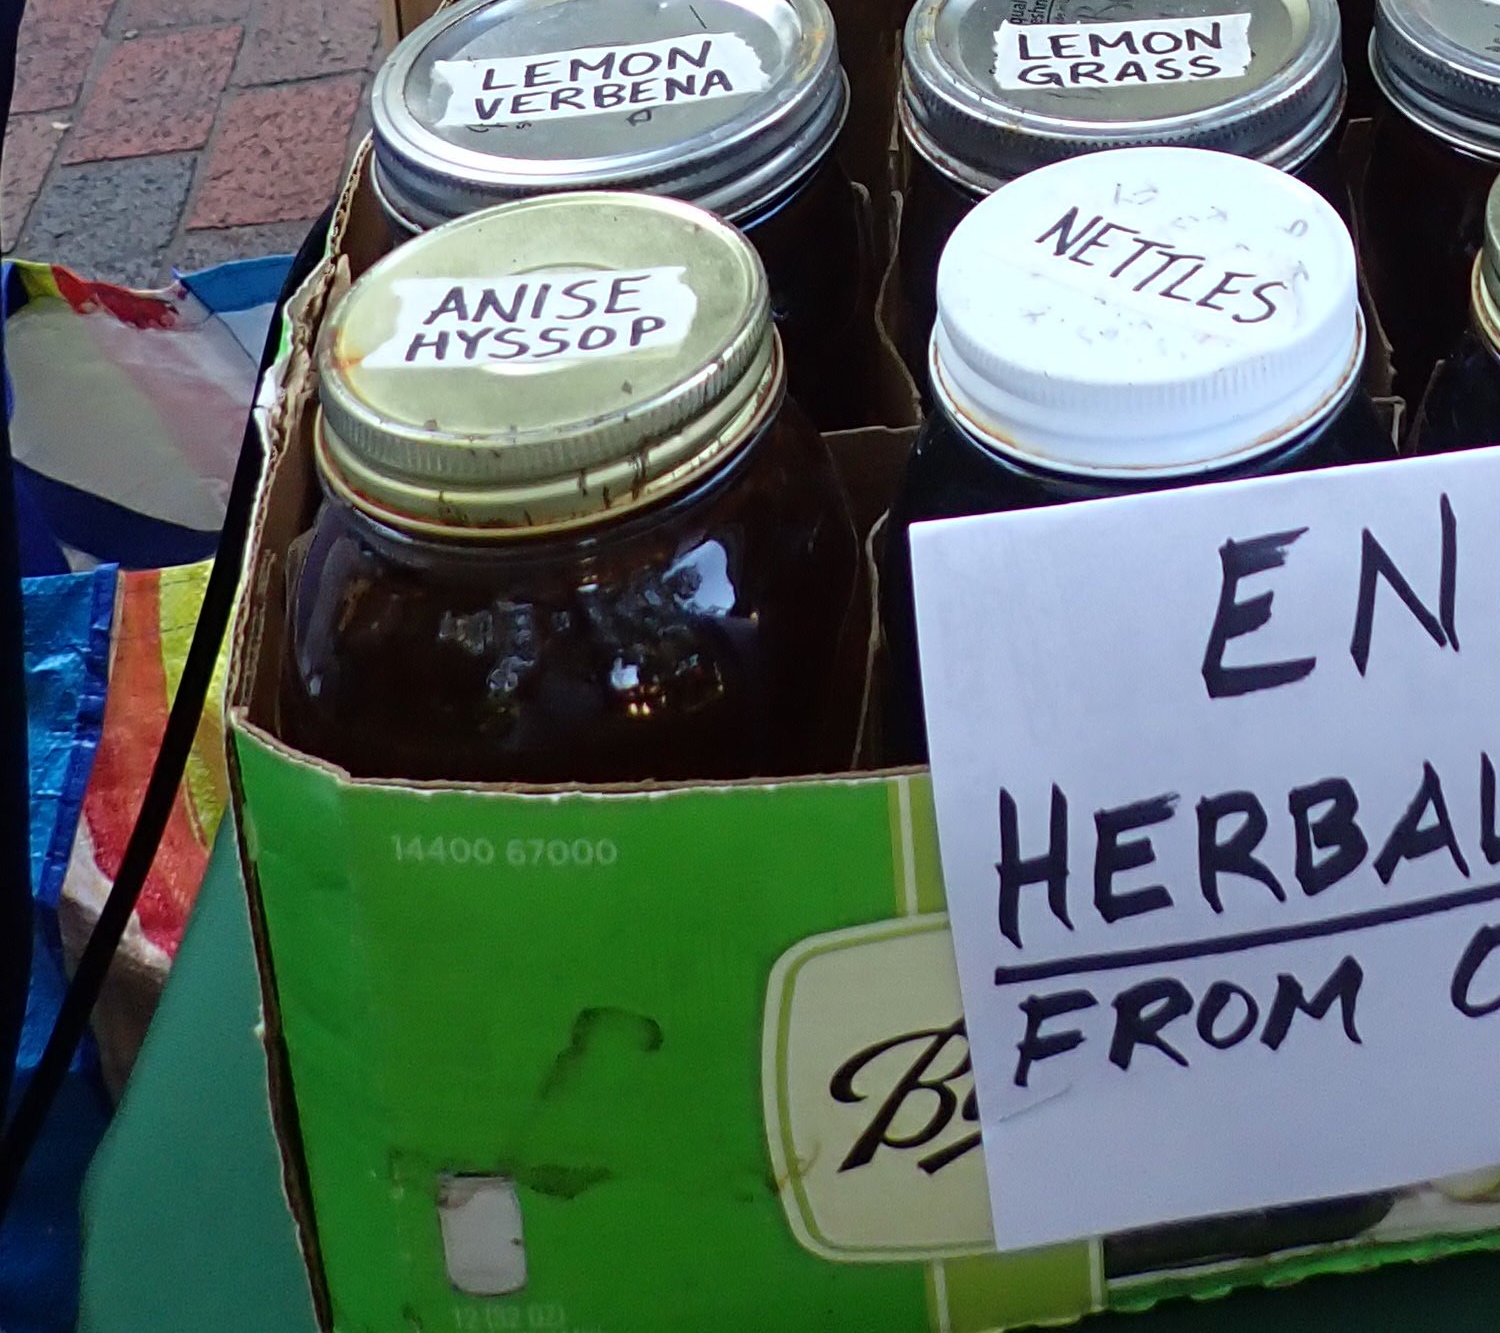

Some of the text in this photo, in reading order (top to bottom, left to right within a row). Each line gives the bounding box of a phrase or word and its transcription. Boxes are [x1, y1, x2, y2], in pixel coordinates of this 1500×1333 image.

[481, 39, 713, 93] LEMON
[1018, 23, 1222, 61] LEMON
[1018, 52, 1222, 86] GRASS
[474, 70, 734, 122] VERBENA
[1034, 206, 1290, 324] NETTLES
[423, 273, 645, 325] ANISE
[405, 313, 667, 362] HYSSOP
[391, 836, 618, 866] 14400 67000
[1013, 955, 1364, 1087] FROM
